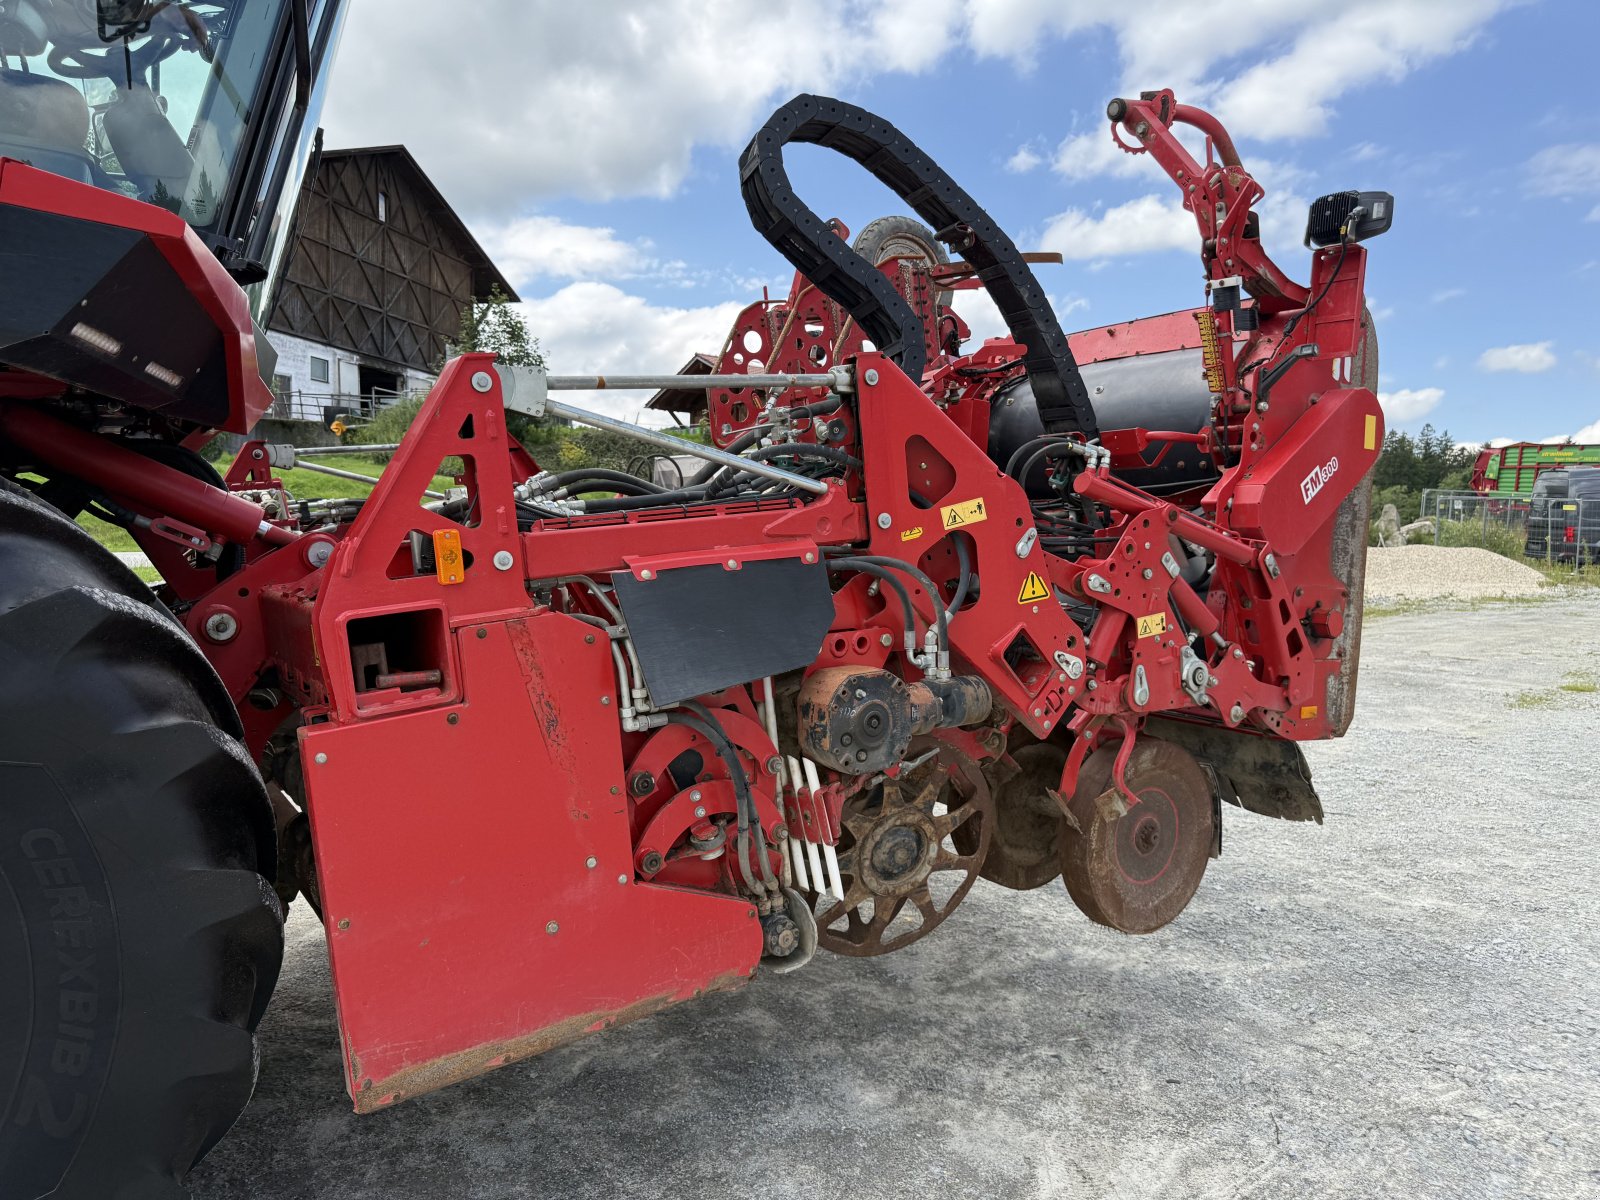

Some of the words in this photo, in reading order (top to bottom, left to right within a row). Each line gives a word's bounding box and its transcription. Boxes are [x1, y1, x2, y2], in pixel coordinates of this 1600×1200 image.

[1302, 469, 1322, 500] FM
[1322, 457, 1338, 482] 300
[20, 828, 98, 1076] CEREXBIB
[14, 1074, 89, 1138] 2
